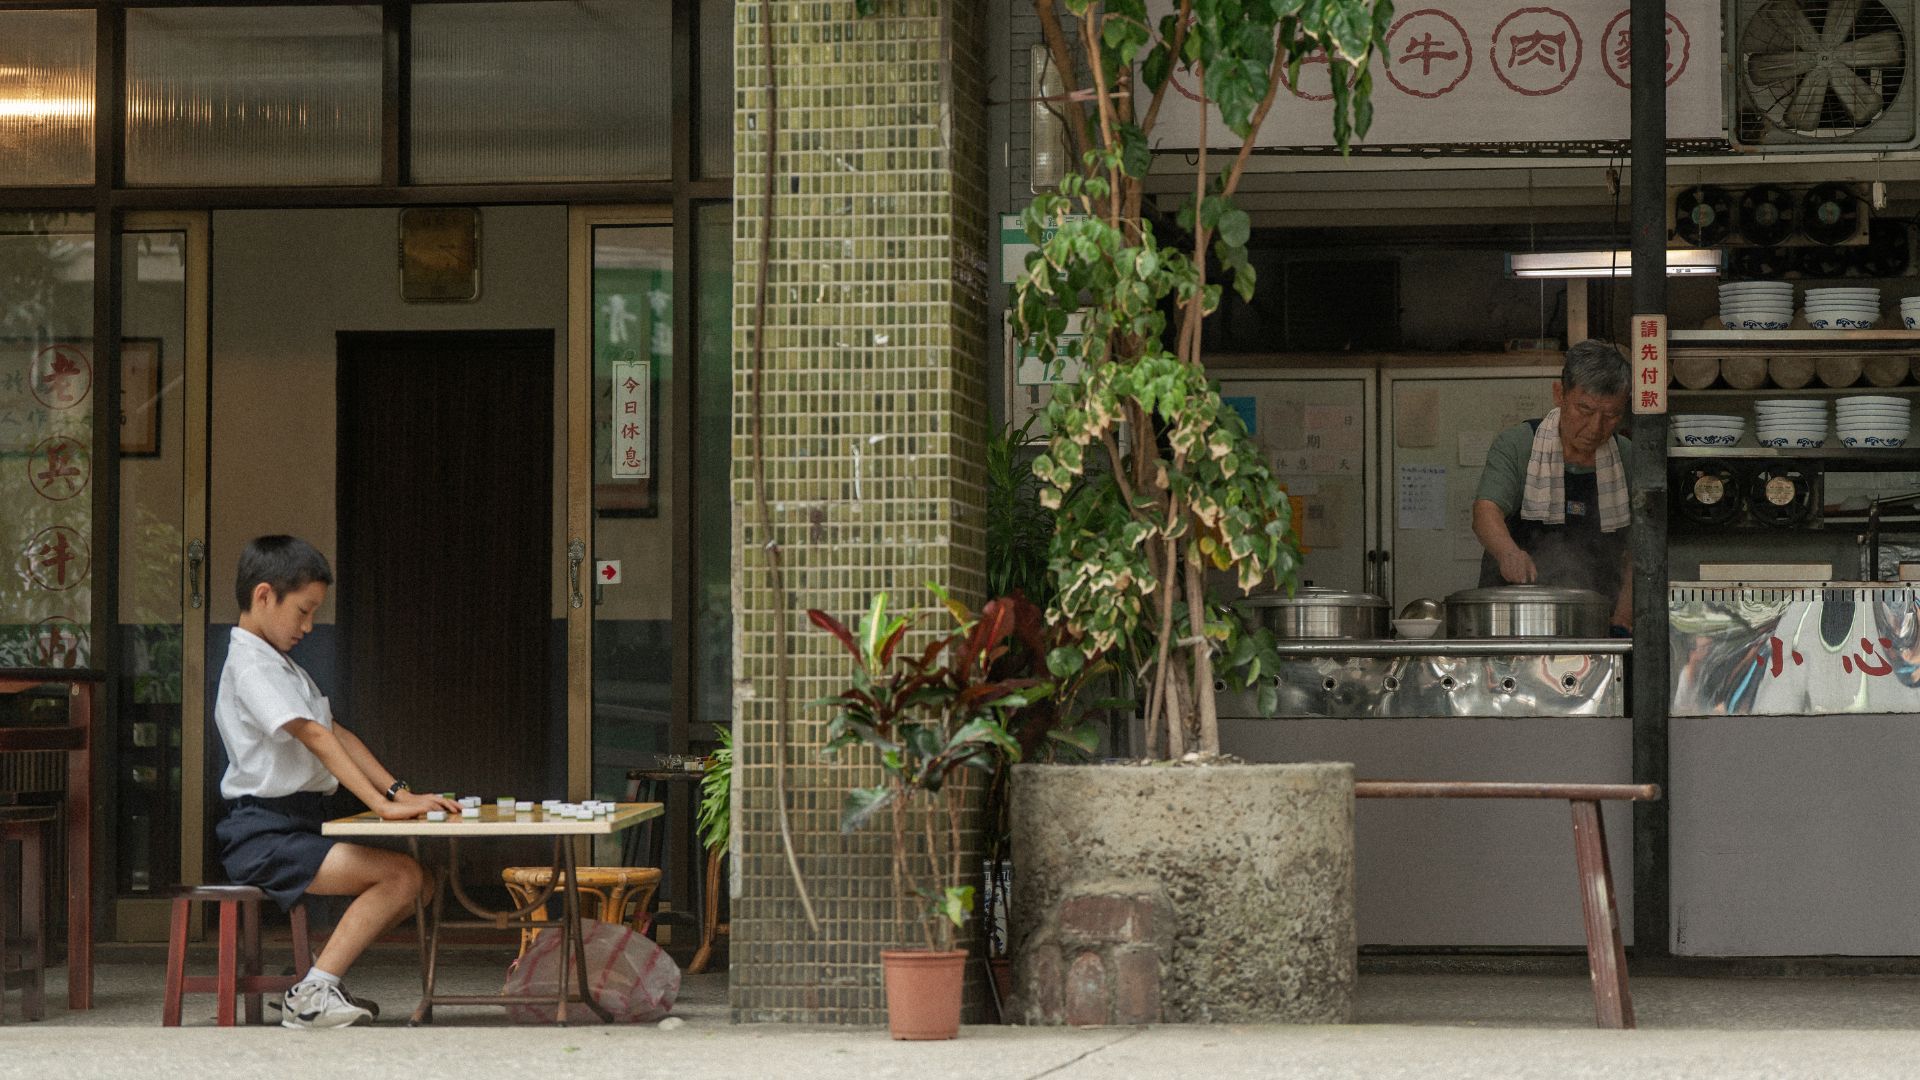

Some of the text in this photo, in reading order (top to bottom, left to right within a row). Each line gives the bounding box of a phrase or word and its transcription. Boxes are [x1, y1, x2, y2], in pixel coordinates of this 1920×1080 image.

[1639, 319, 1659, 408] 請先付款
[620, 376, 641, 468] 今日休息
[1756, 636, 1893, 679] 小心
